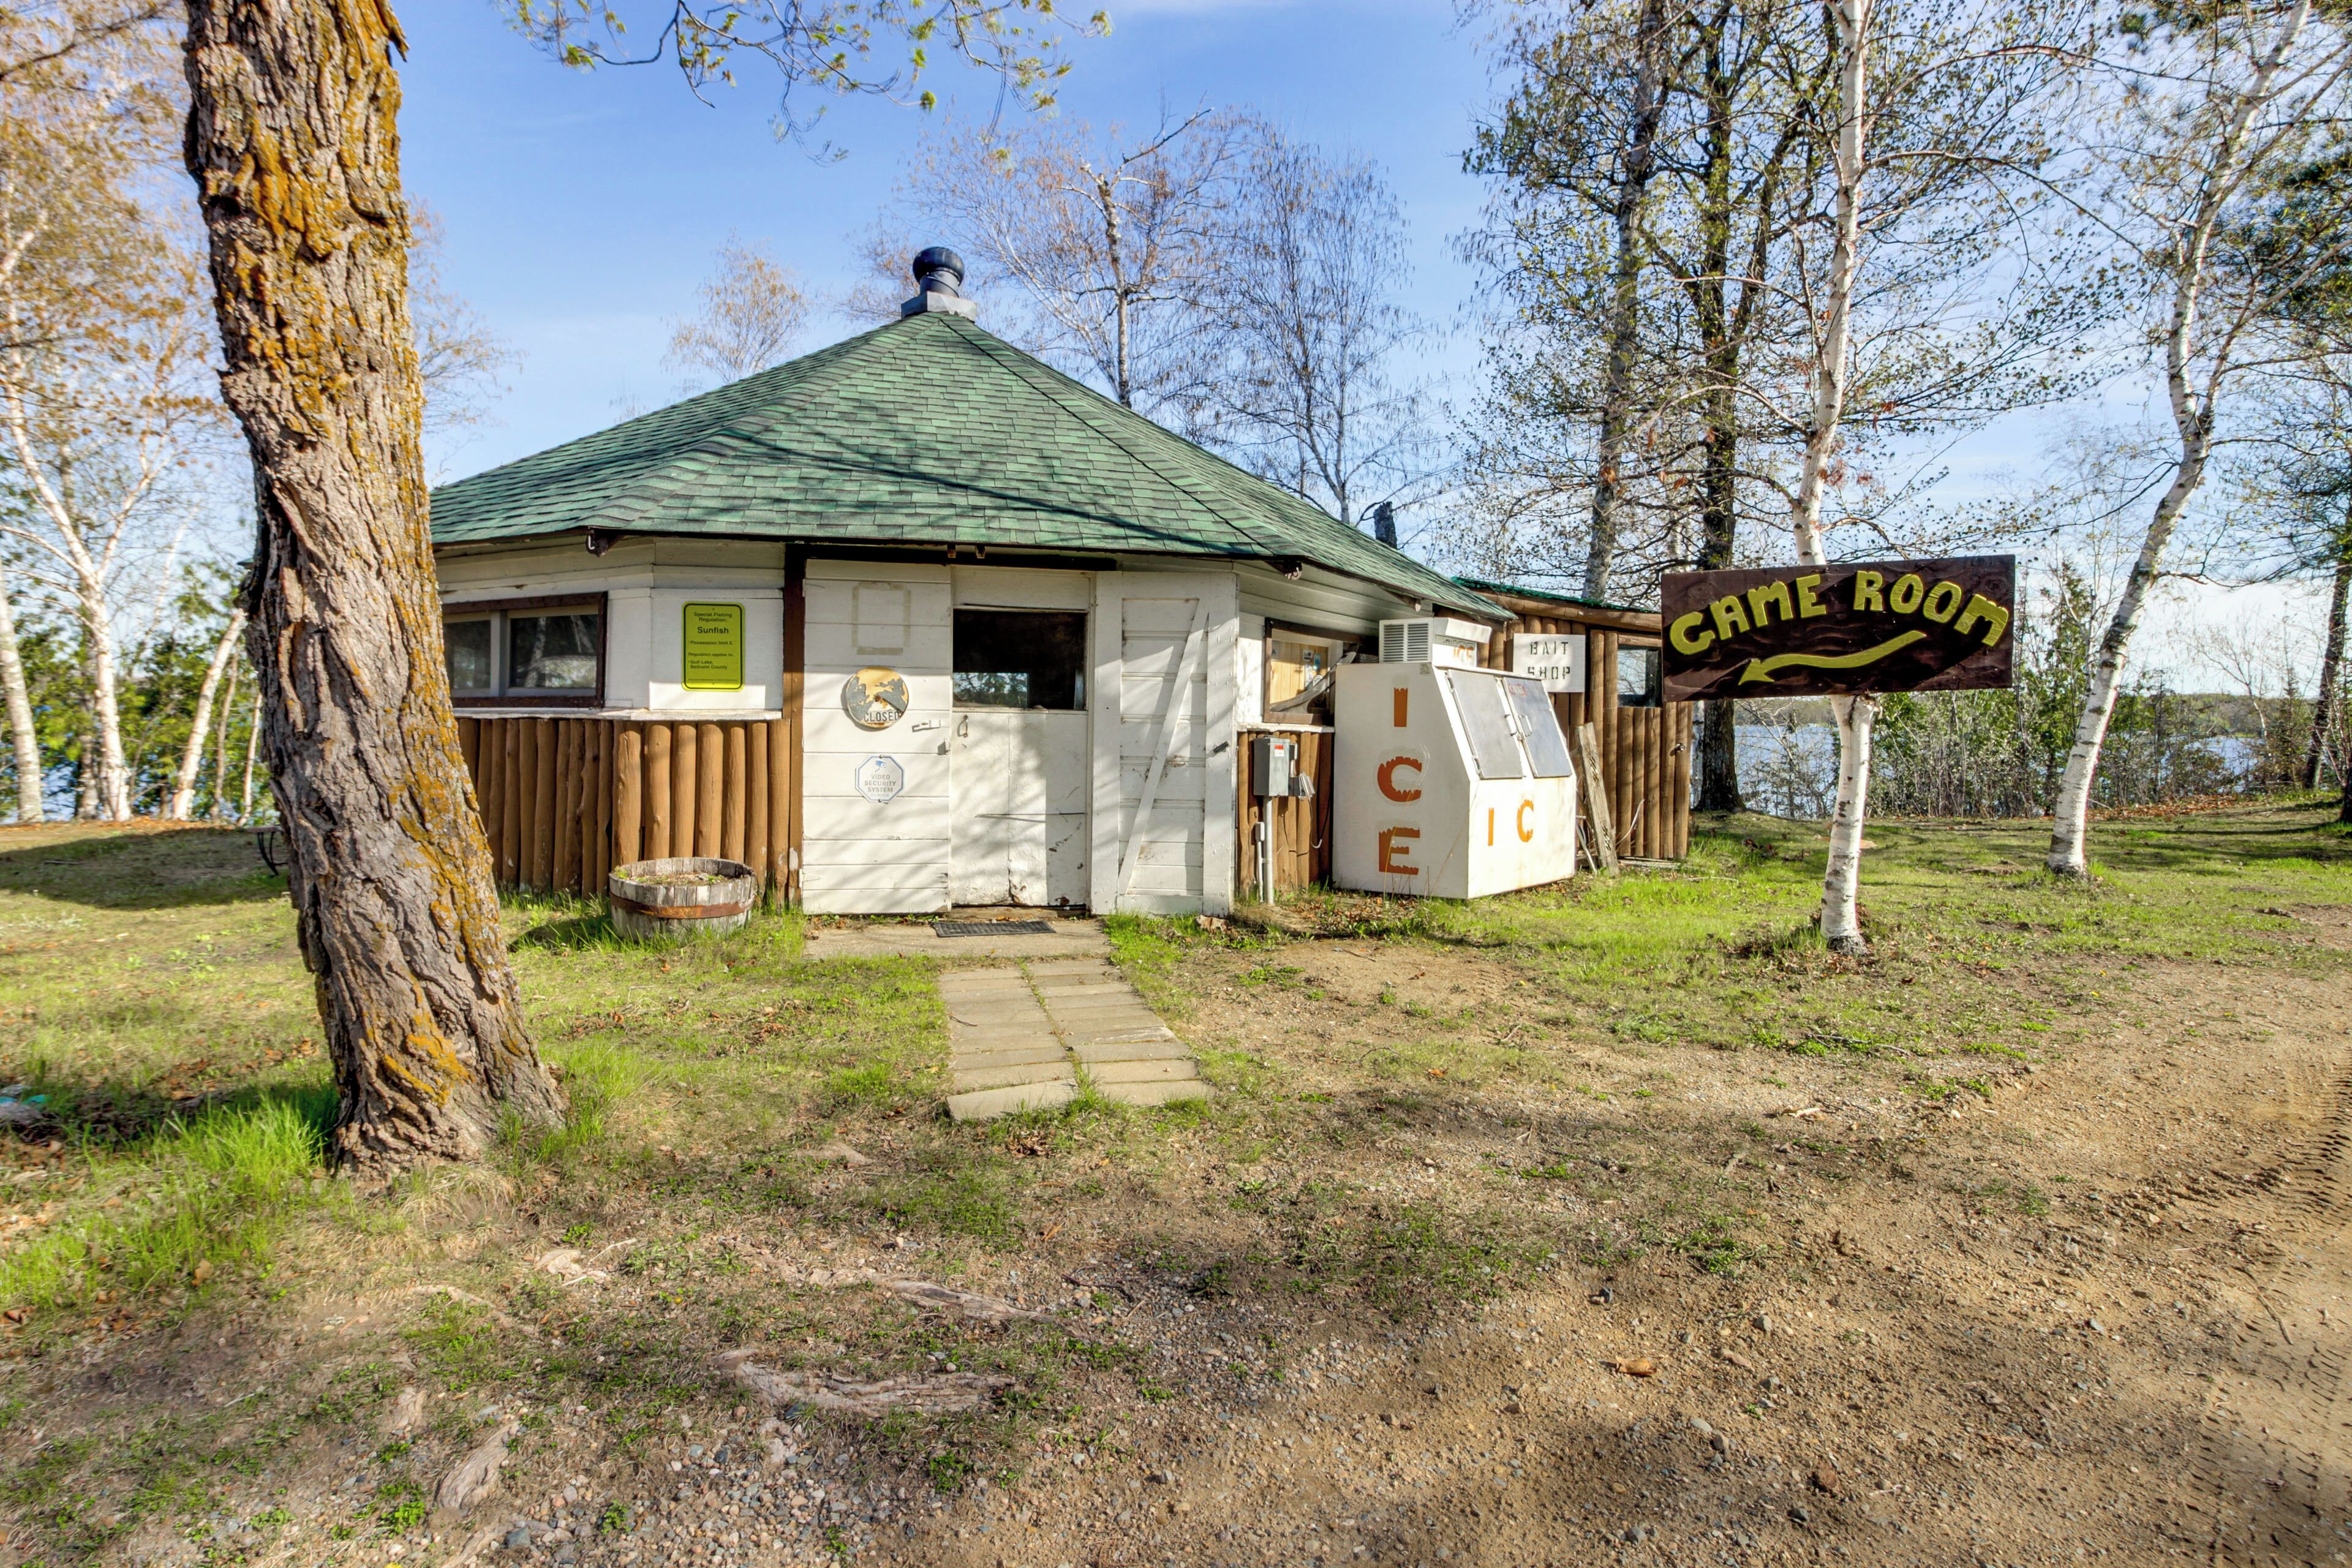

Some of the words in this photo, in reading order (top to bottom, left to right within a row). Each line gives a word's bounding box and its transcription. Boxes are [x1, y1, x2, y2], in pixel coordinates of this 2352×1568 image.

[1669, 573, 1827, 656] GAME
[1853, 570, 2010, 647] ROOM
[1529, 641, 1569, 655] BAIT
[1527, 666, 1570, 680] SHOP
[864, 711, 900, 722] CLOSED
